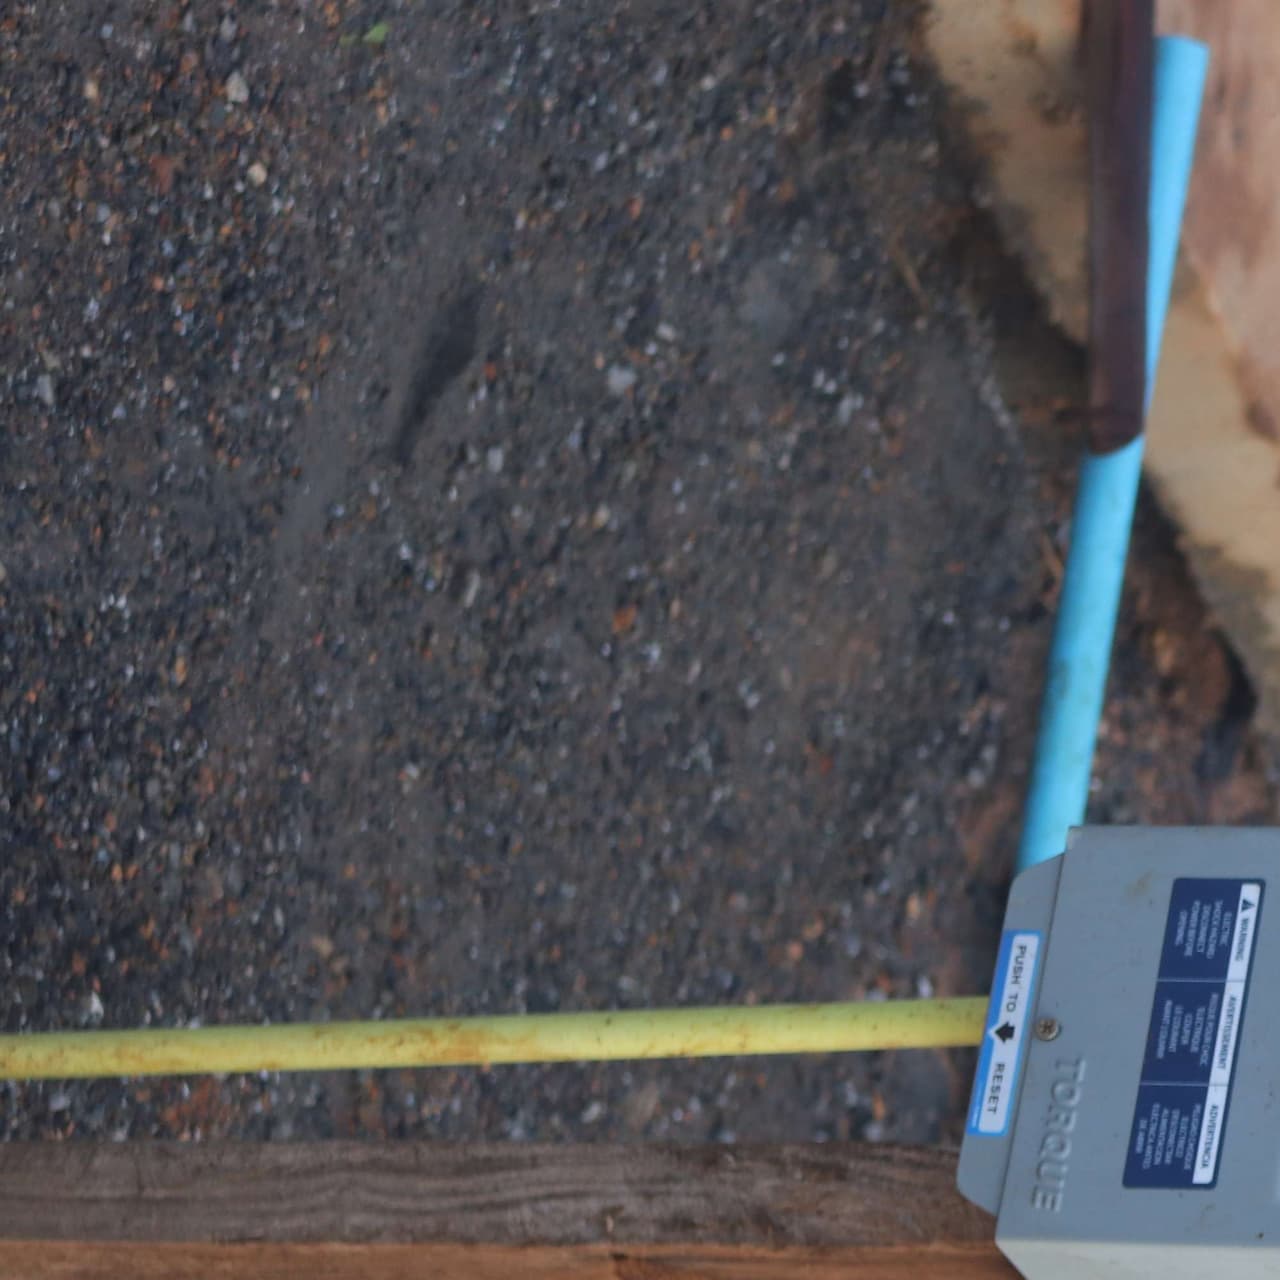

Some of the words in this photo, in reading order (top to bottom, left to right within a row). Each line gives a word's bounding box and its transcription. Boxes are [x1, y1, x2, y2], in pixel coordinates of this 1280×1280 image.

[1011, 944, 1027, 984] PUSH
[1235, 918, 1250, 961] WARNING
[1005, 992, 1019, 1014] TO
[986, 1061, 1006, 1116] RESET
[1030, 1056, 1087, 1214] TORQUE
[1200, 1105, 1219, 1169] ADVERTENCIA
